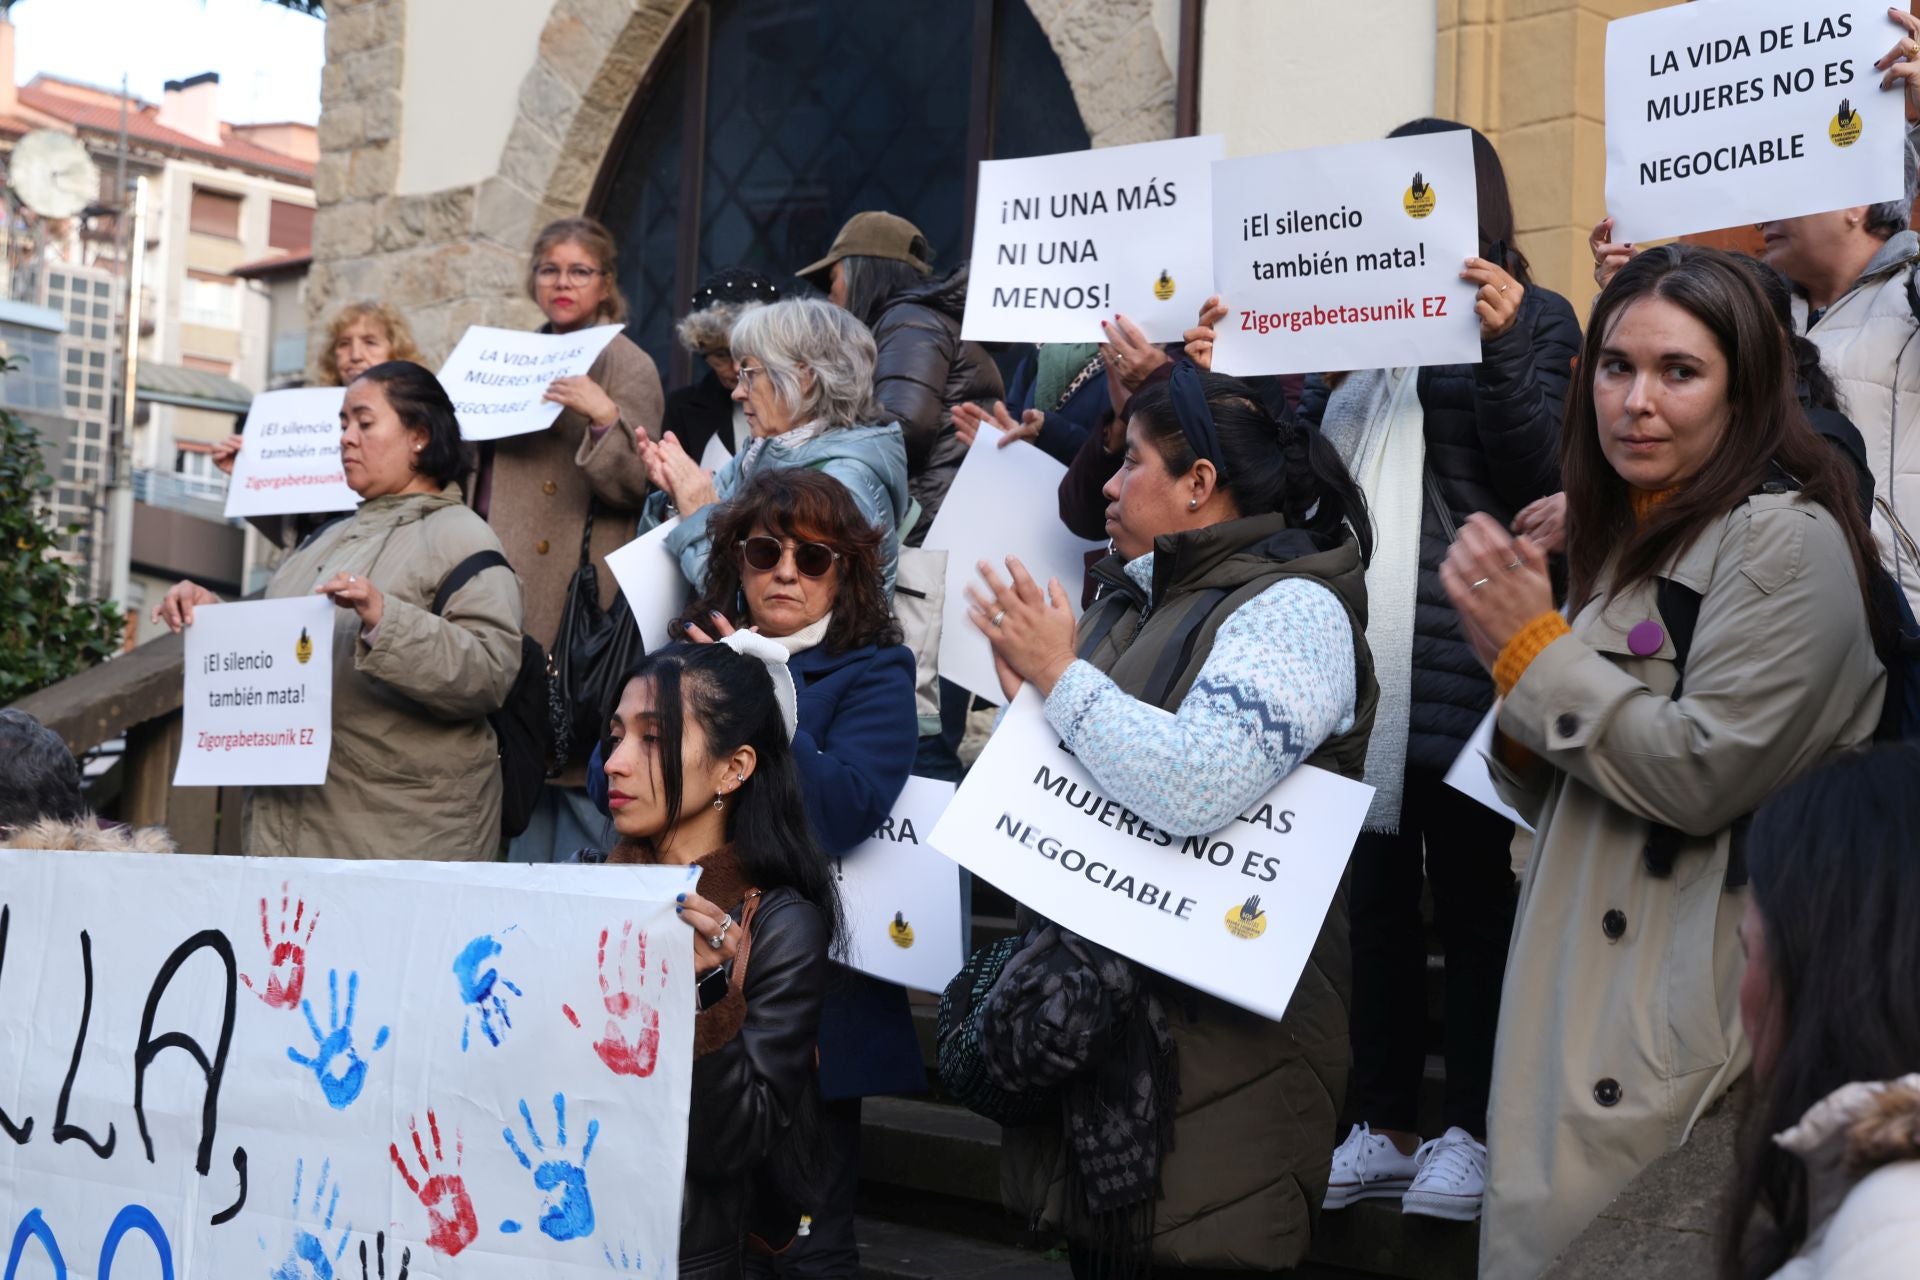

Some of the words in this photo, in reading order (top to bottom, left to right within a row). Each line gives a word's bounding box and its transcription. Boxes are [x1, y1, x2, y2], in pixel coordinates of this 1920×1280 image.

[1650, 51, 1680, 77] LA
[1687, 35, 1751, 68] VIDA
[1760, 25, 1794, 53] DE
[1803, 13, 1852, 44] LAS
[1647, 77, 1764, 122] MUJERES
[1773, 68, 1815, 97] NO
[1824, 59, 1855, 88] ES
[1640, 133, 1805, 186] NEGOCIABLE
[1002, 197, 1040, 224] ¡NI
[1051, 190, 1108, 218] UNA
[1117, 177, 1177, 211] MÁS
[1243, 213, 1269, 241] ¡El
[1275, 206, 1363, 235] silencio
[997, 243, 1026, 265] NI
[1037, 239, 1098, 264] UNA
[1252, 251, 1348, 281] también
[1356, 242, 1426, 271] mata!
[992, 283, 1110, 309] MENOS!
[1240, 297, 1416, 334] Zigorgabetasunik
[1422, 296, 1448, 318] EZ
[479, 349, 498, 362] LA
[503, 351, 538, 367] VIDA
[541, 353, 560, 366] DE
[560, 346, 584, 362] LAS
[464, 369, 530, 387] MUJERES
[533, 370, 555, 384] NO
[452, 399, 530, 415] EGOCIABLE
[281, 420, 333, 436] silencio
[261, 443, 316, 460] también
[204, 653, 220, 675] ¡El
[223, 650, 274, 672] silencio
[208, 686, 263, 708] también
[266, 683, 305, 705] mata!
[197, 728, 297, 752] Zigorgabetasunik
[299, 728, 314, 746] EZ
[1033, 764, 1173, 848] MUJERES
[1180, 835, 1235, 867] NO
[1240, 850, 1281, 883] ES
[994, 809, 1198, 922] NEGOCIABLE
